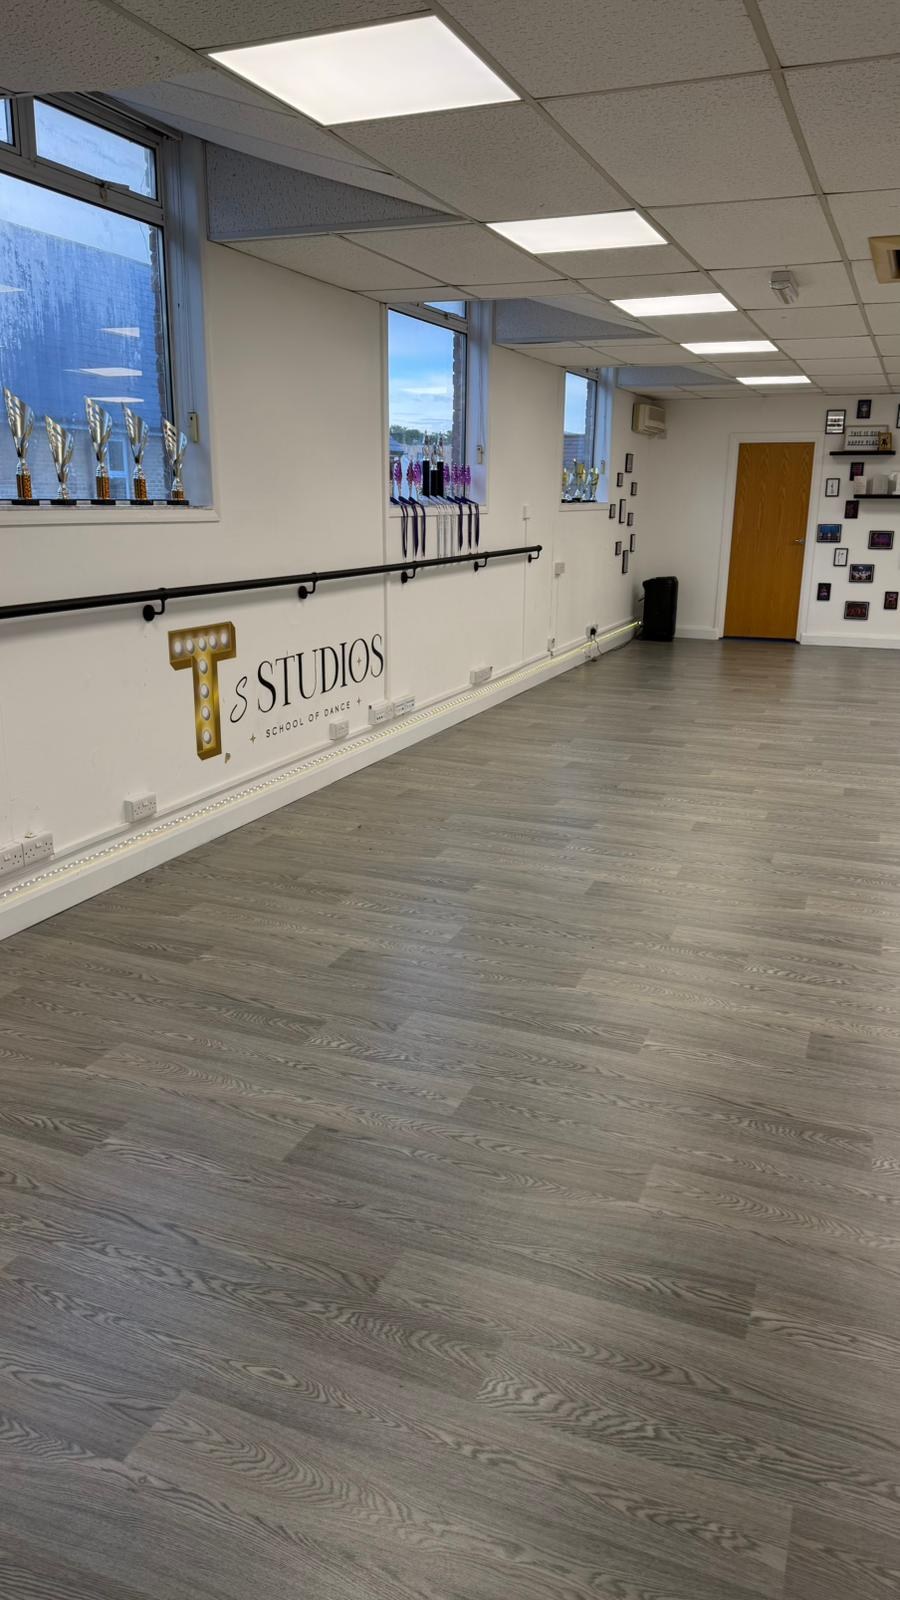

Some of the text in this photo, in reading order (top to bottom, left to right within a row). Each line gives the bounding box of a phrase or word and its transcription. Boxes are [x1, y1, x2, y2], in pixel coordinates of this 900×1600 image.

[257, 633, 384, 713] STUDIOS
[265, 701, 351, 738] SCHOOL OF DANCE
